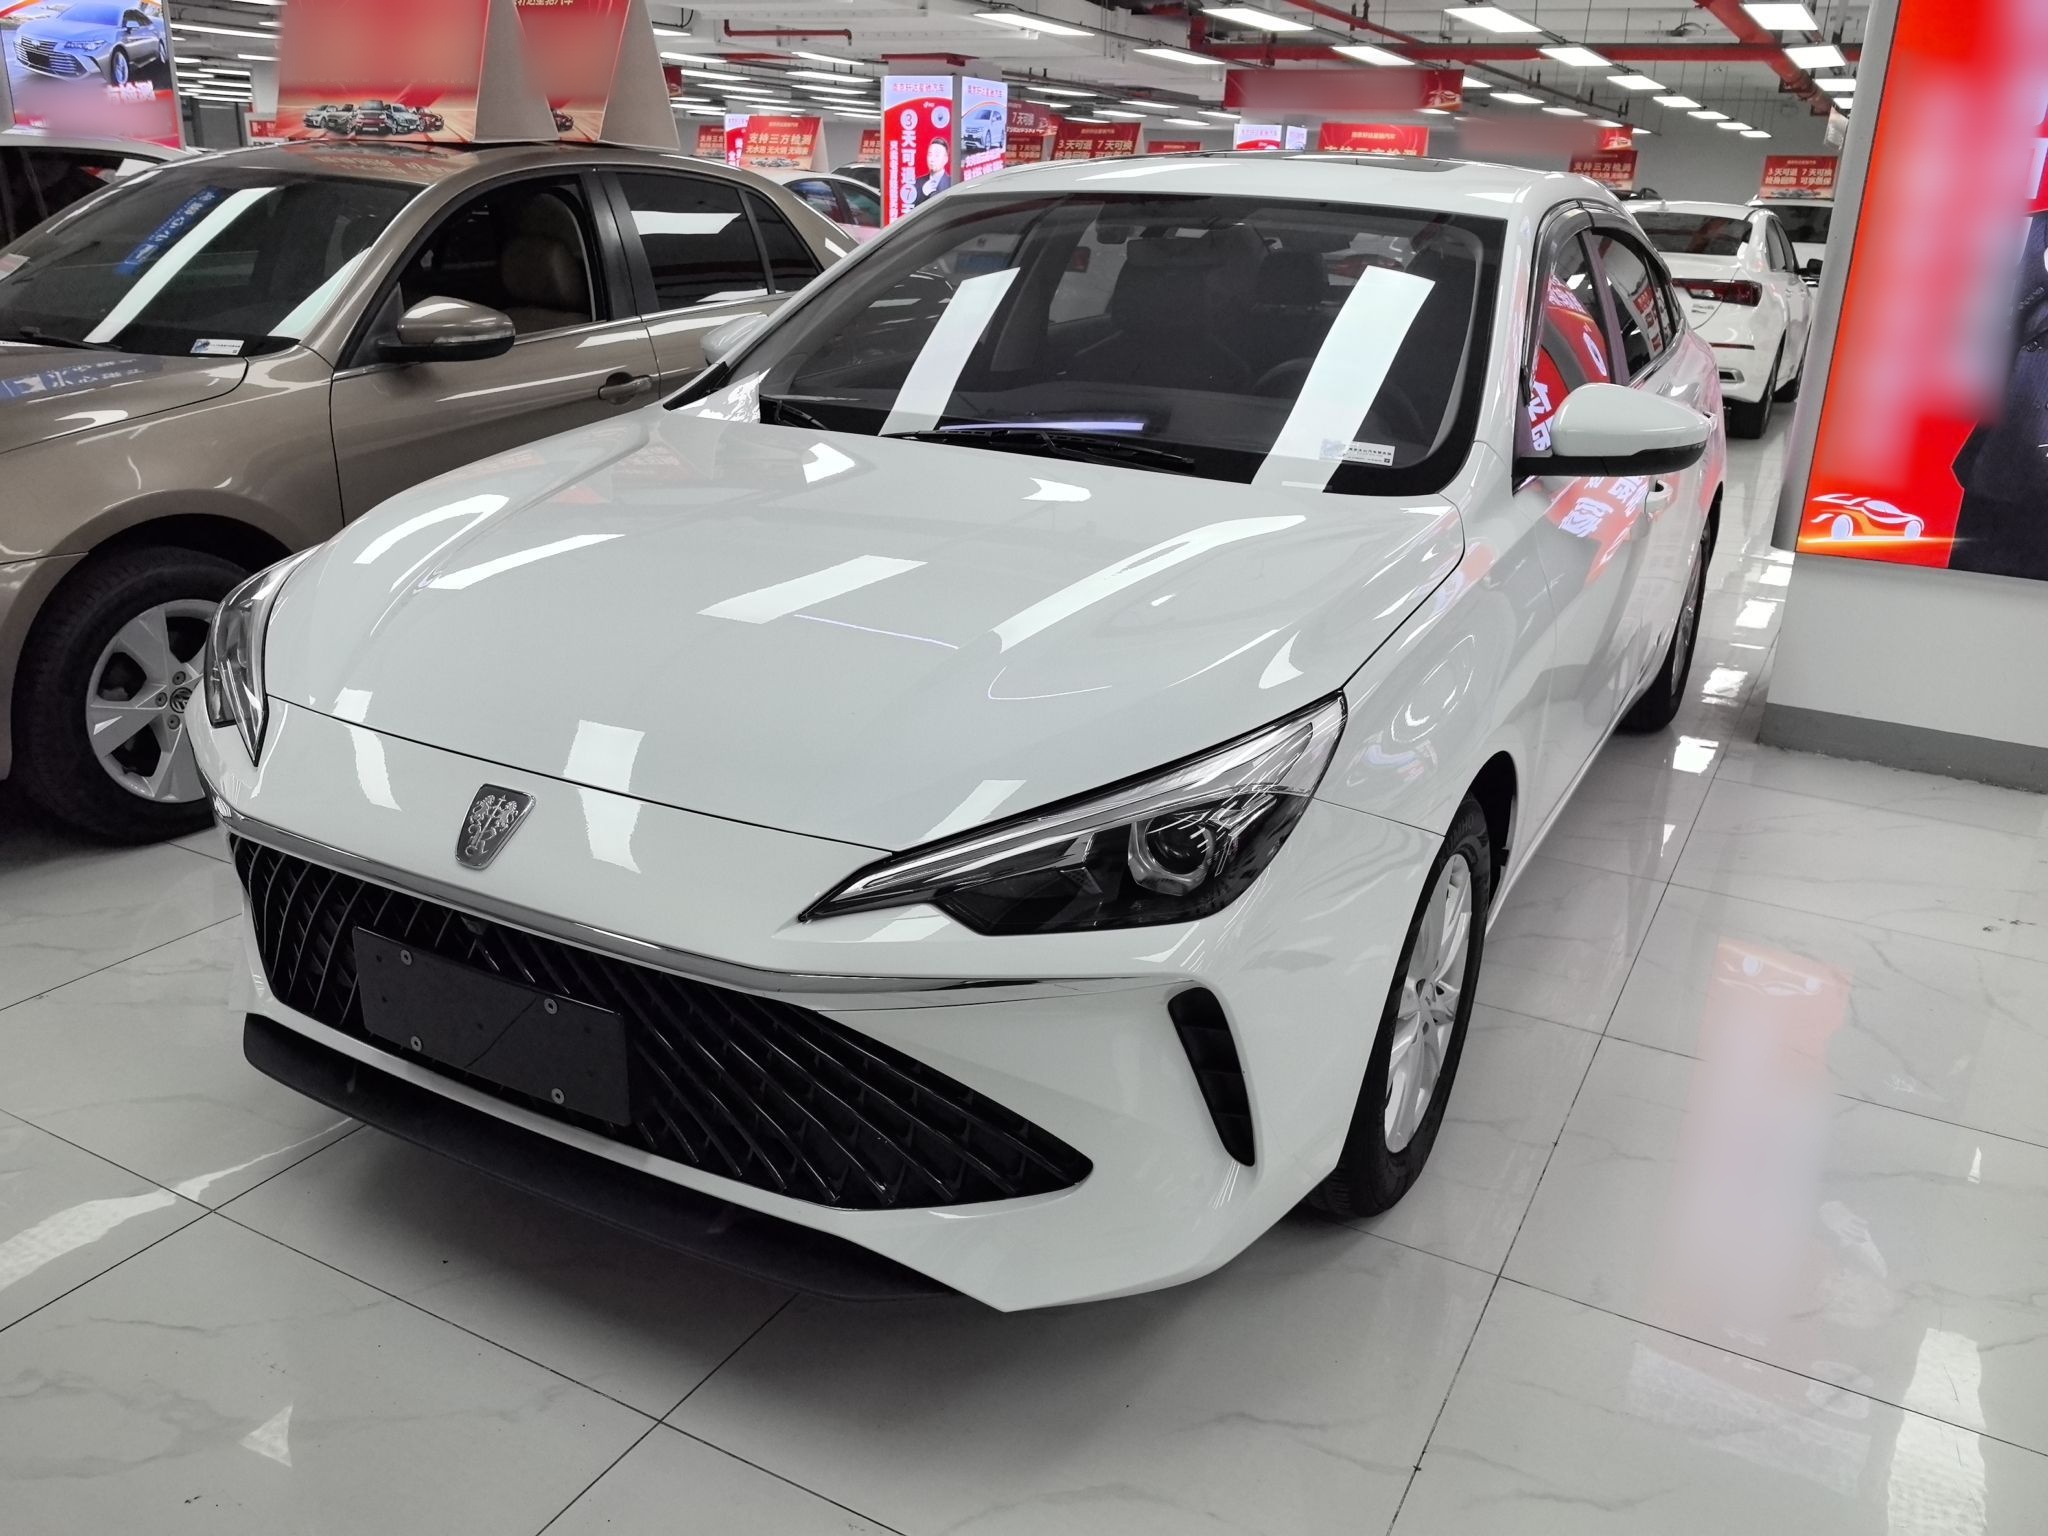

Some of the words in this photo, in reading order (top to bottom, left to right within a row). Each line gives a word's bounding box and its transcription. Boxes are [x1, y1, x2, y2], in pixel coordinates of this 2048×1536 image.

[748, 132, 813, 145] 支持三方检测
